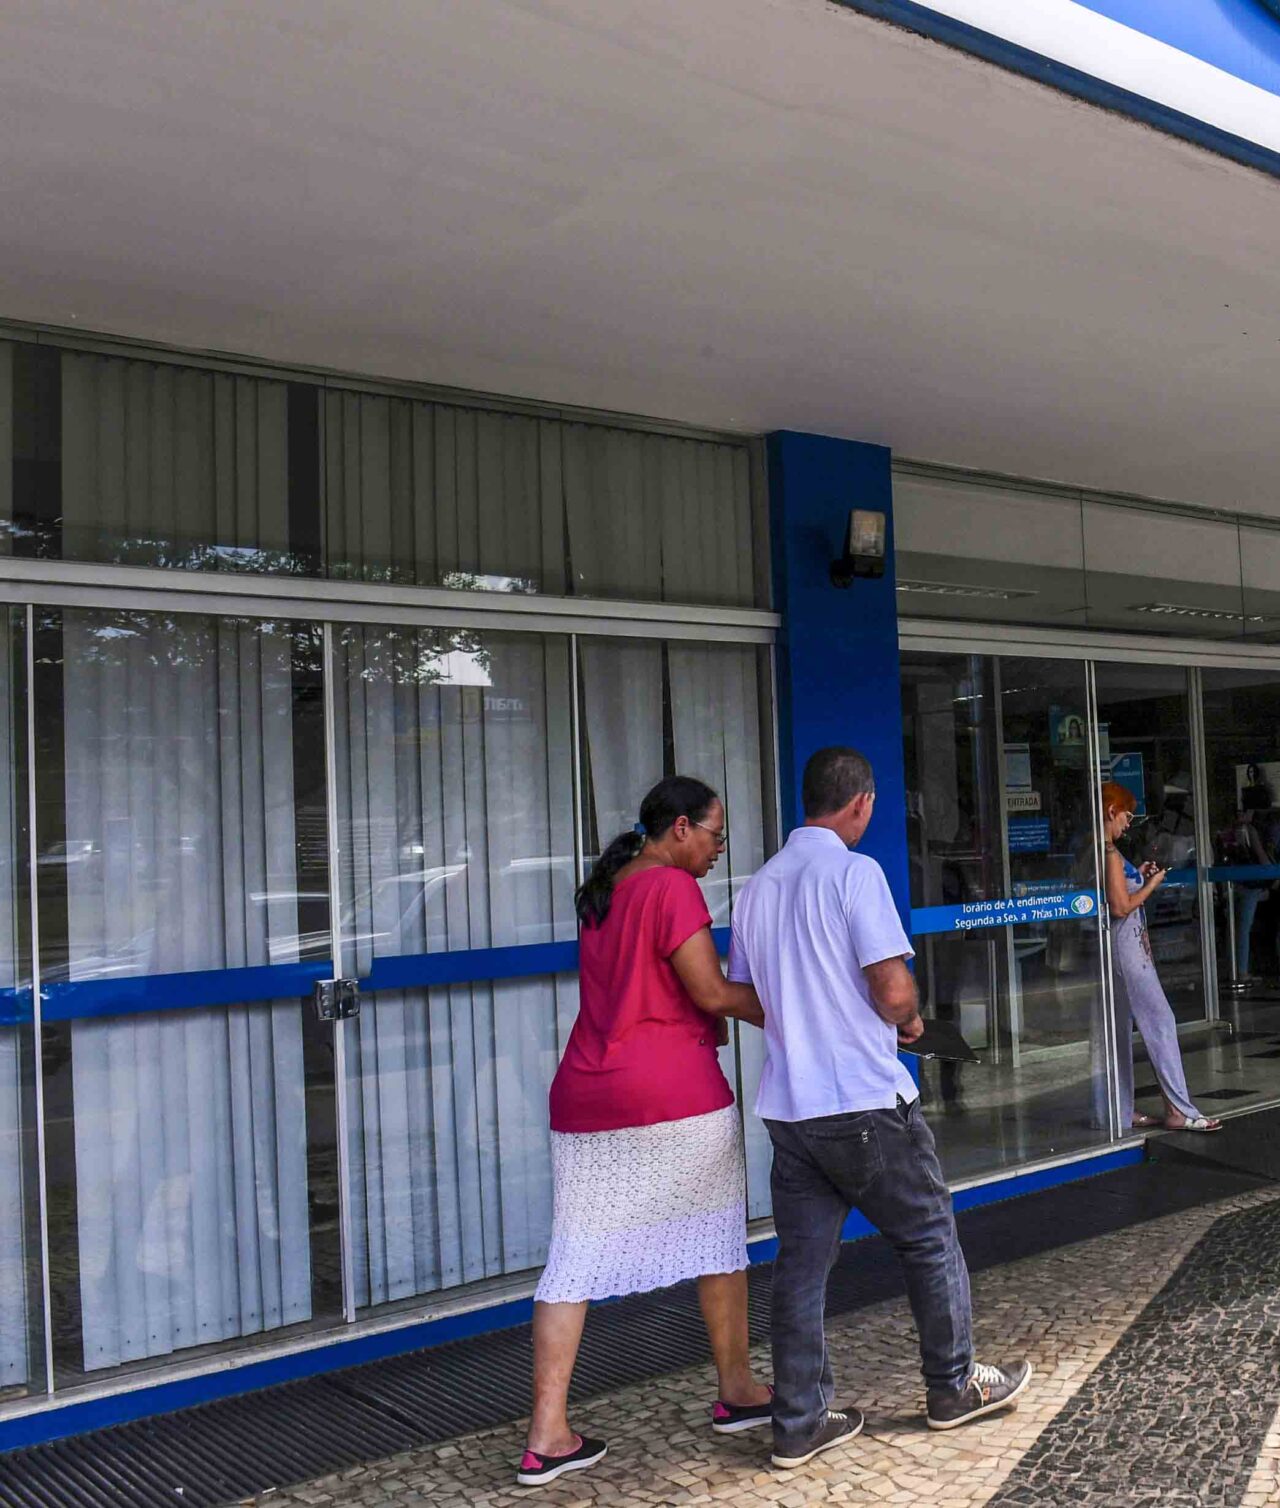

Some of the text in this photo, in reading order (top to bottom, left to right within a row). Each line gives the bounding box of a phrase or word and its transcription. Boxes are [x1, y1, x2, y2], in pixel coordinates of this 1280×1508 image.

[994, 899, 1006, 910] de
[955, 915, 995, 931] Segunda
[996, 916, 1002, 924] a
[1054, 907, 1069, 918] 17h
